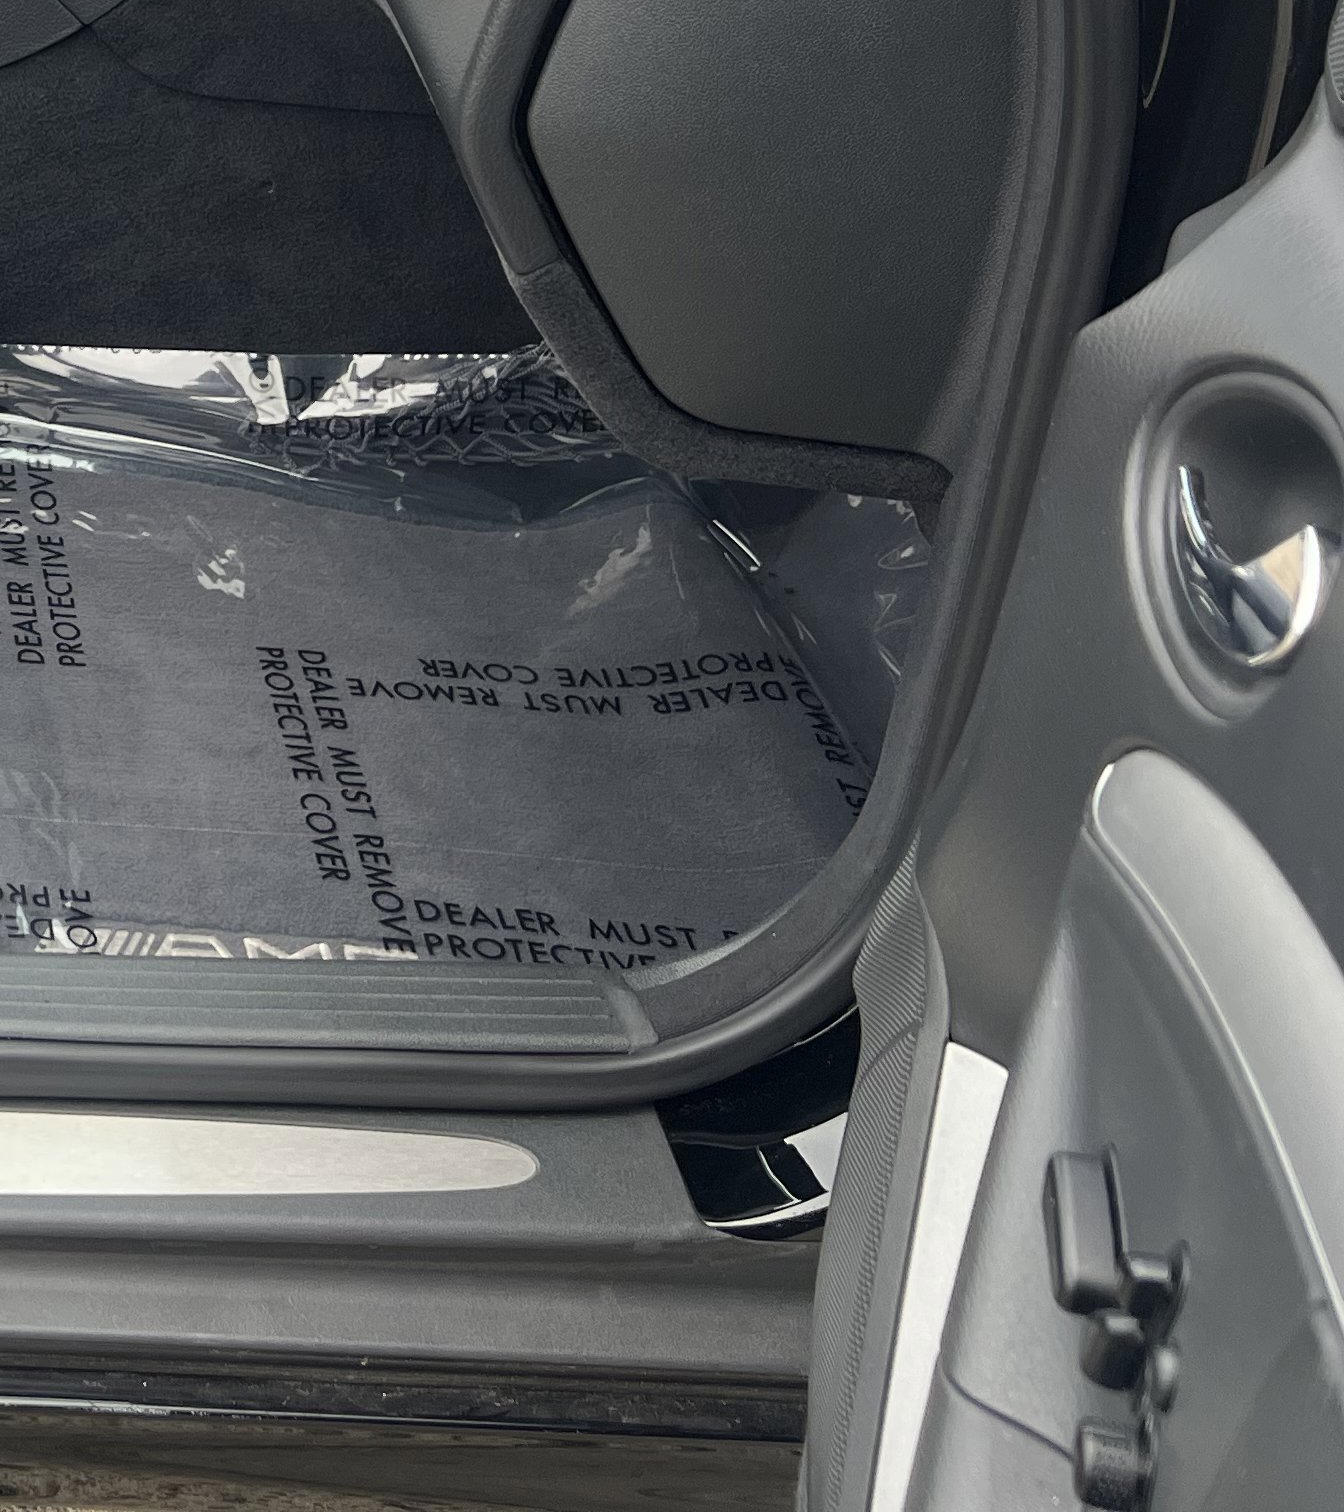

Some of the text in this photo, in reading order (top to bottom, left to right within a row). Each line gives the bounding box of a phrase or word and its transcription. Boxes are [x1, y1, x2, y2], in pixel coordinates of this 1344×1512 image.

[504, 409, 608, 433] COVE
[6, 580, 46, 665] DEALER
[35, 534, 87, 667] PROTECTIVE
[345, 677, 789, 716] DEALER MUST REMOVE
[416, 651, 775, 688] PROTECTIVE COVER
[255, 646, 352, 882] PROTECTIVE COVER
[298, 649, 418, 953] DEALER MUST REMOVE
[413, 899, 698, 952] DEALER MUST
